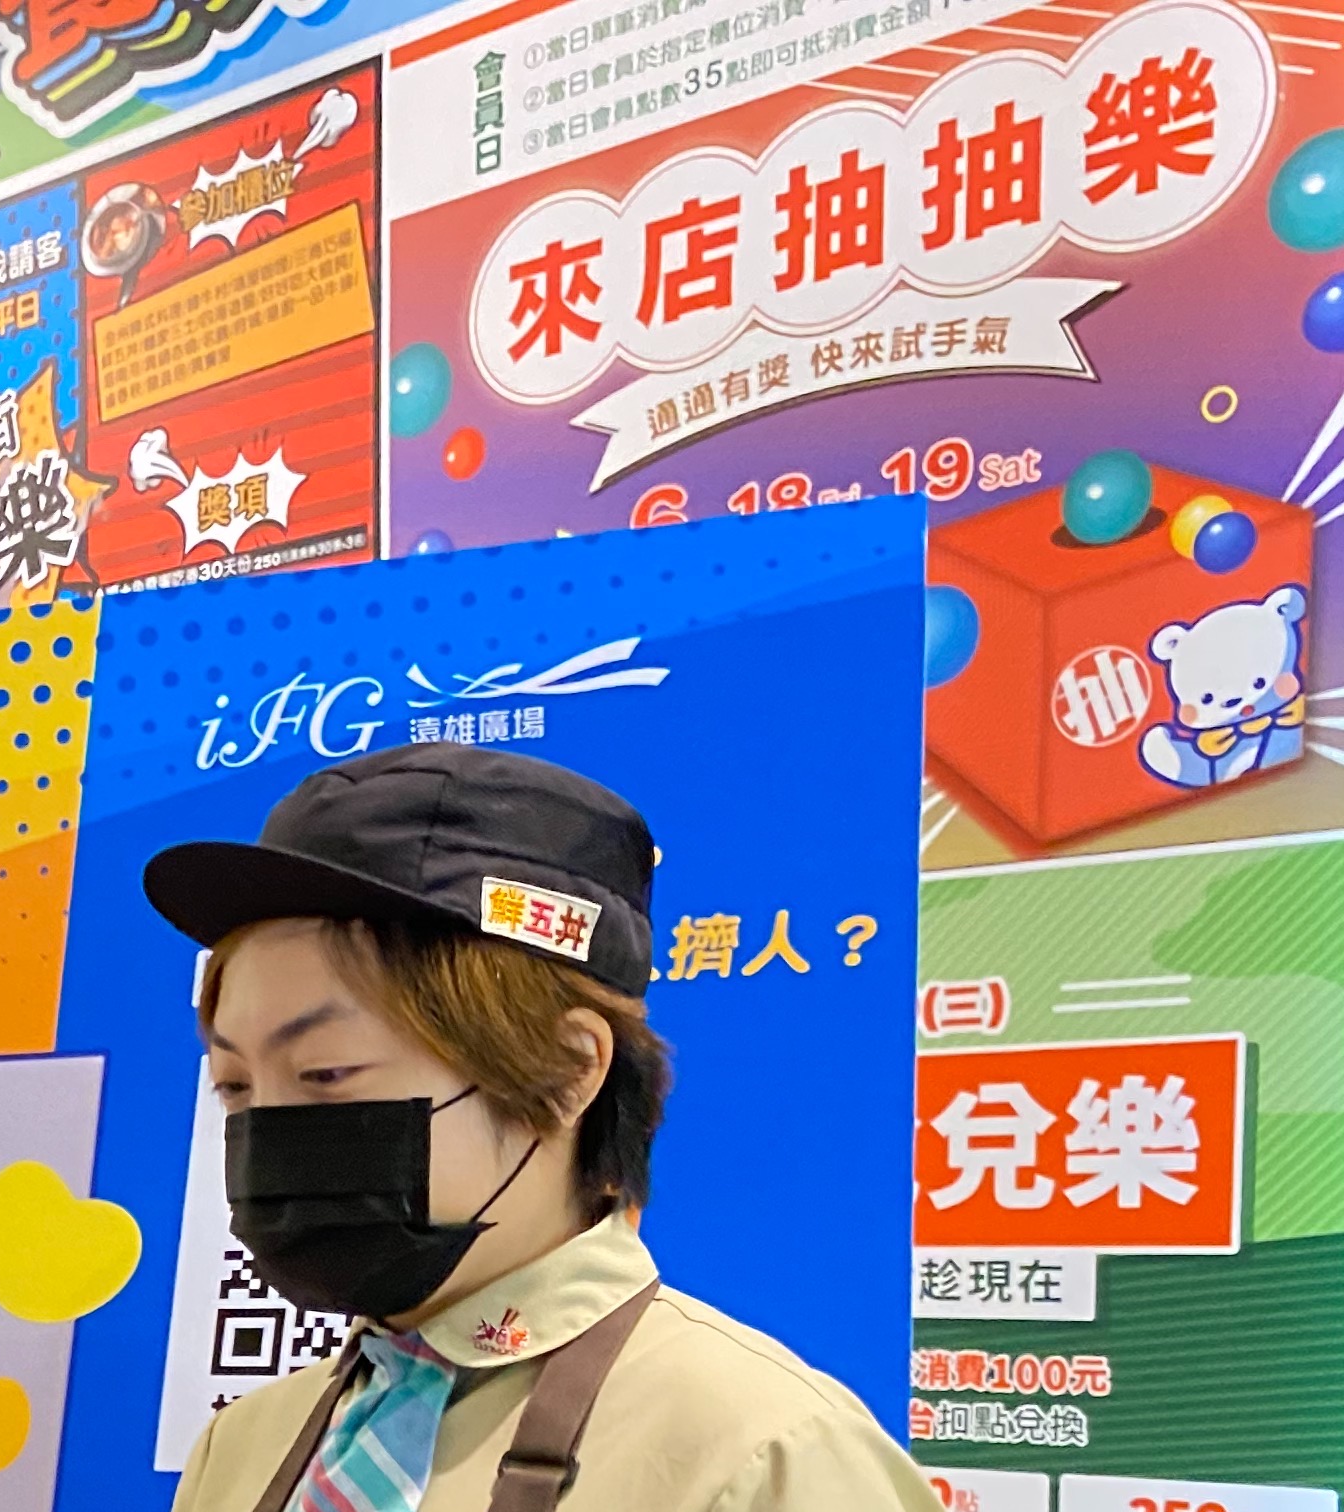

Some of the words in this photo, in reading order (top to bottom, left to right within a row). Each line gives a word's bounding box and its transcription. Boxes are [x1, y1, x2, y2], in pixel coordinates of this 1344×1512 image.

[472, 49, 506, 174] 會員日
[507, 47, 1220, 367] 來店抽抽樂
[646, 357, 791, 441] 通通有獎
[810, 315, 1012, 382] 快來試手氣
[882, 437, 974, 501] 19
[978, 448, 1042, 492] Sat
[197, 473, 269, 533] 獎項
[409, 706, 546, 745] 遠雄廣場
[487, 886, 588, 952] 鮮五丼
[652, 909, 878, 982] 擠人？
[914, 1075, 1201, 1210] 兌樂
[920, 1258, 1064, 1304] 趁現在
[918, 1352, 1109, 1393] 消費100元
